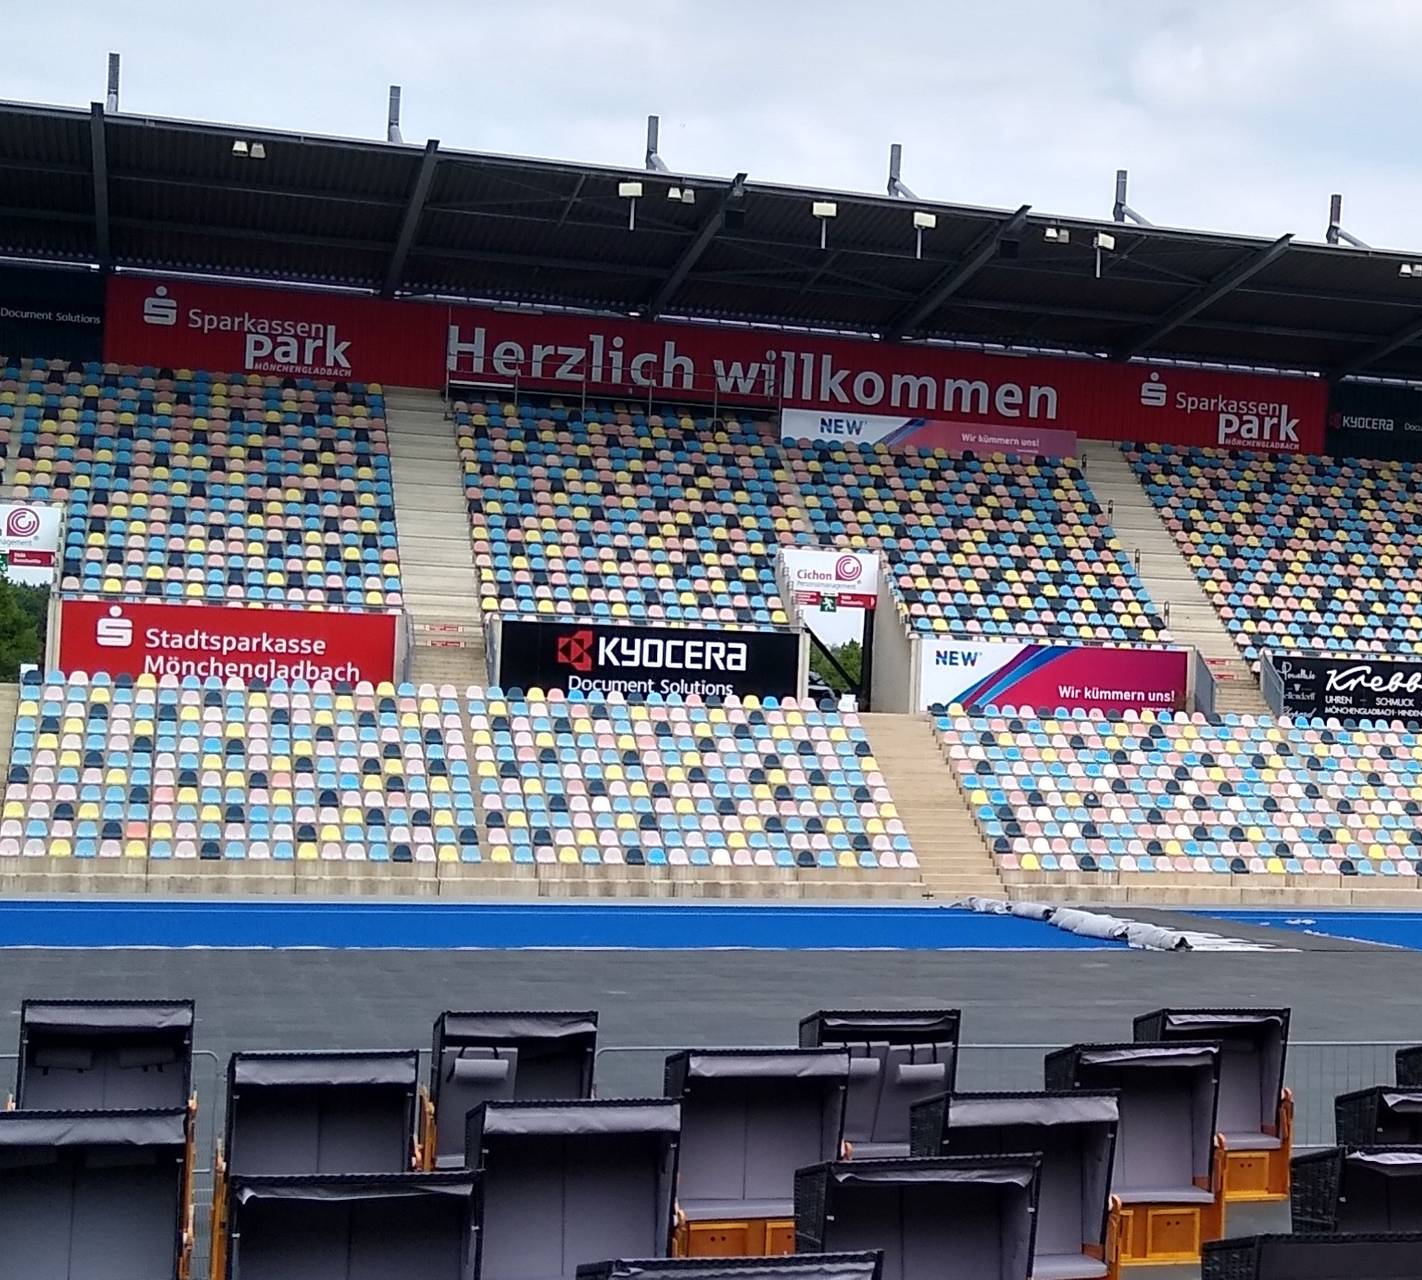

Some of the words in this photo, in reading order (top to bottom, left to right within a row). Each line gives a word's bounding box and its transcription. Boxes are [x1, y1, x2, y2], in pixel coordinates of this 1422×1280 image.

[1, 306, 53, 321] Document
[56, 310, 101, 325] Solutions
[188, 308, 325, 338] Sparkassen
[245, 325, 352, 369] park
[254, 361, 352, 378] MÖNCHENGLADBACH
[448, 325, 695, 390] Herzlich
[713, 350, 1058, 420] willkommen
[1176, 391, 1280, 416] Sparkassen
[820, 417, 863, 436] NEW
[1218, 405, 1300, 445] park
[1342, 415, 1394, 431] KYOCERA
[961, 433, 977, 443] Wir
[978, 434, 1020, 446] kümmern
[1021, 438, 1040, 448] uns!
[1225, 438, 1300, 451] MÖNCHENGLADBACH
[796, 569, 832, 581] Cichon
[145, 628, 327, 655] Stadtsparkasse
[598, 636, 748, 671] KYOCERA
[935, 650, 977, 667] NEW
[144, 655, 361, 683] Mönchengladbach
[568, 675, 655, 693] Document
[660, 679, 734, 697] Solutions
[1058, 685, 1081, 699] Wir
[1084, 686, 1145, 701] kümmern
[1148, 690, 1175, 702] uns!
[1325, 695, 1353, 705] UHREN
[1375, 697, 1414, 708] SCHMUCK
